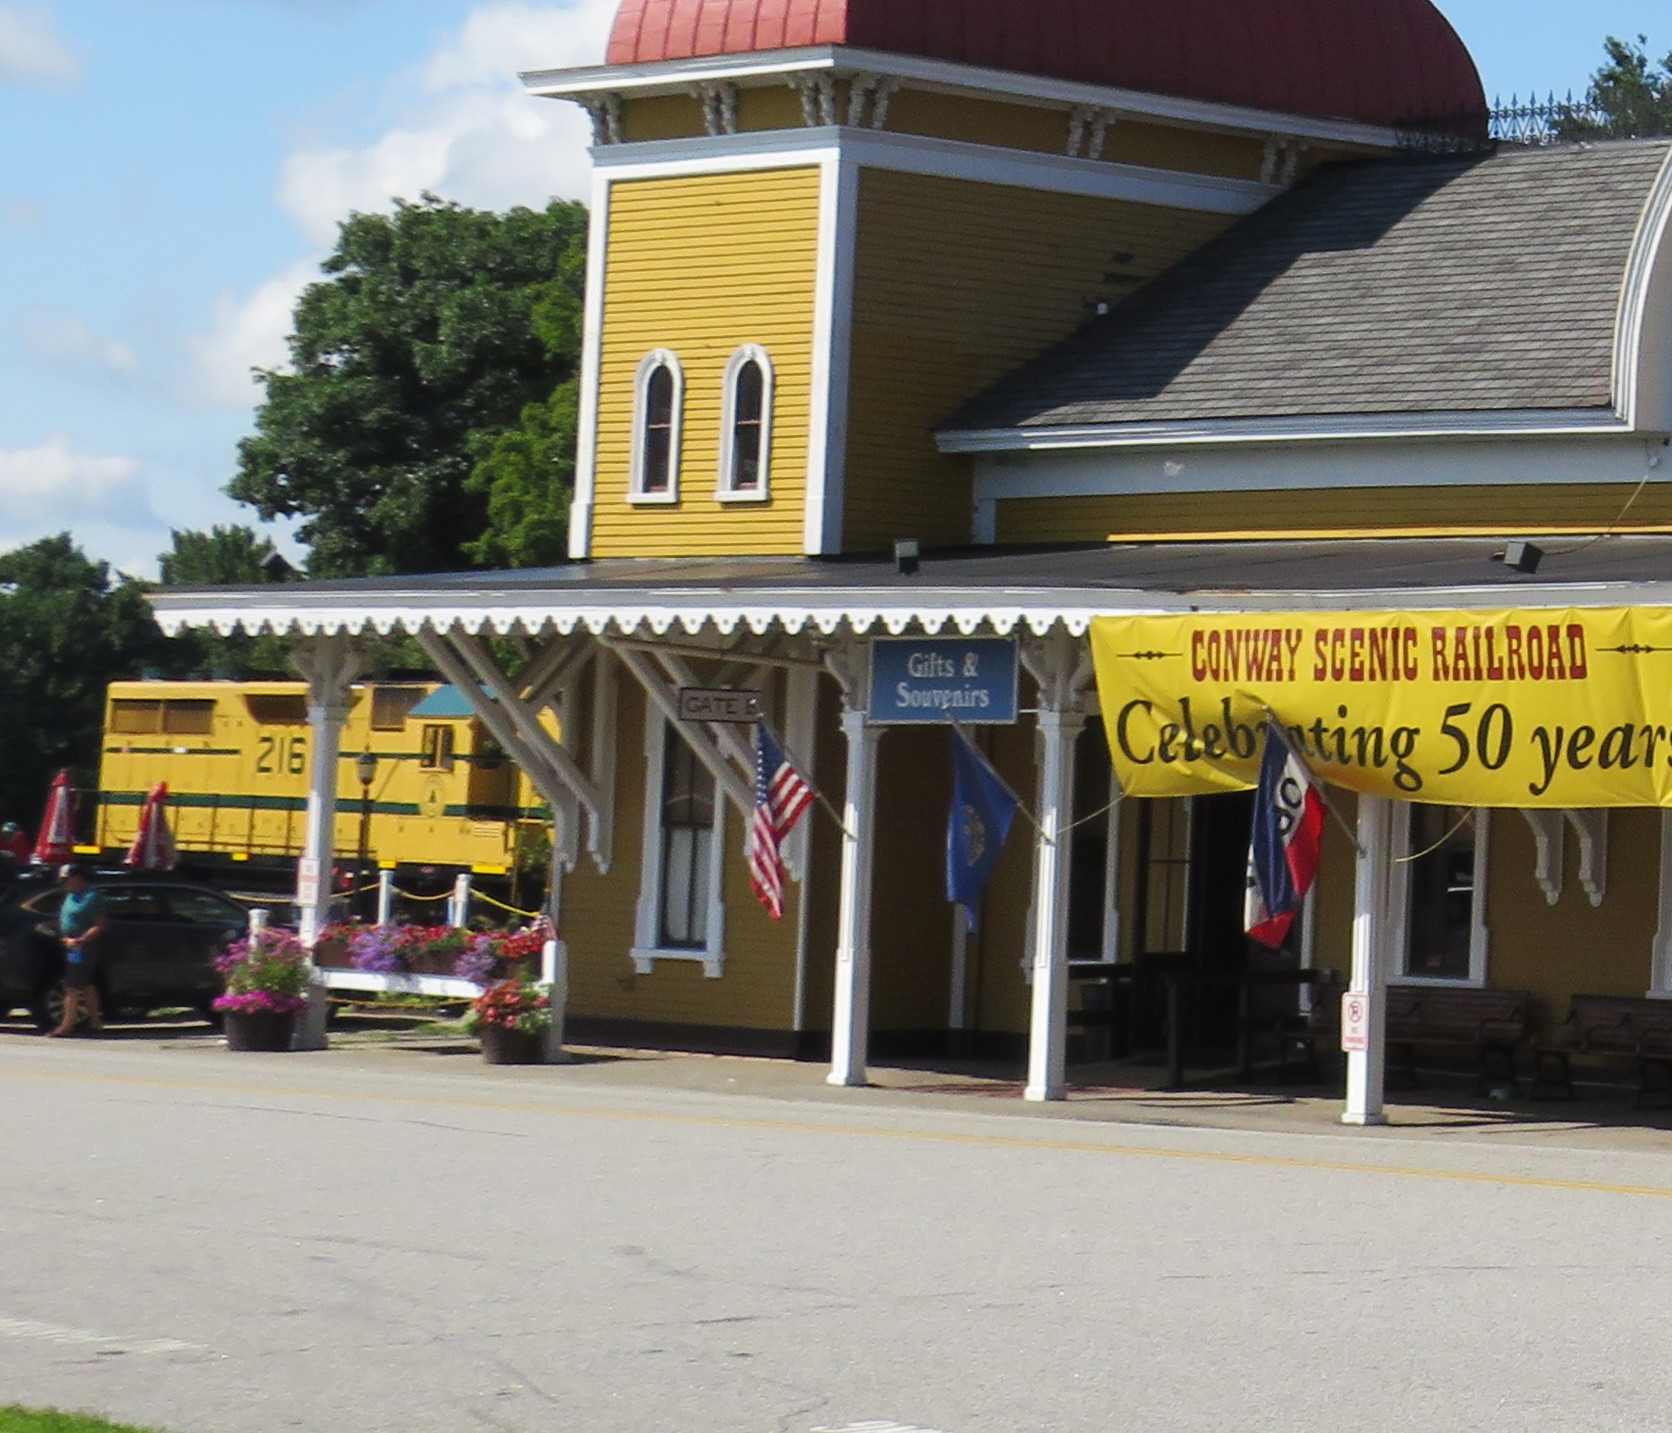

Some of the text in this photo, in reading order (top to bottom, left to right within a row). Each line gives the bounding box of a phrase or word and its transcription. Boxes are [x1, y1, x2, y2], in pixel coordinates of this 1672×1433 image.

[907, 651, 979, 678] Gifts &
[1191, 624, 1588, 683] CONWAY SCENIC RAILROAD
[896, 681, 990, 709] Souvenirs
[256, 736, 306, 774] 216
[1438, 702, 1513, 776] 50
